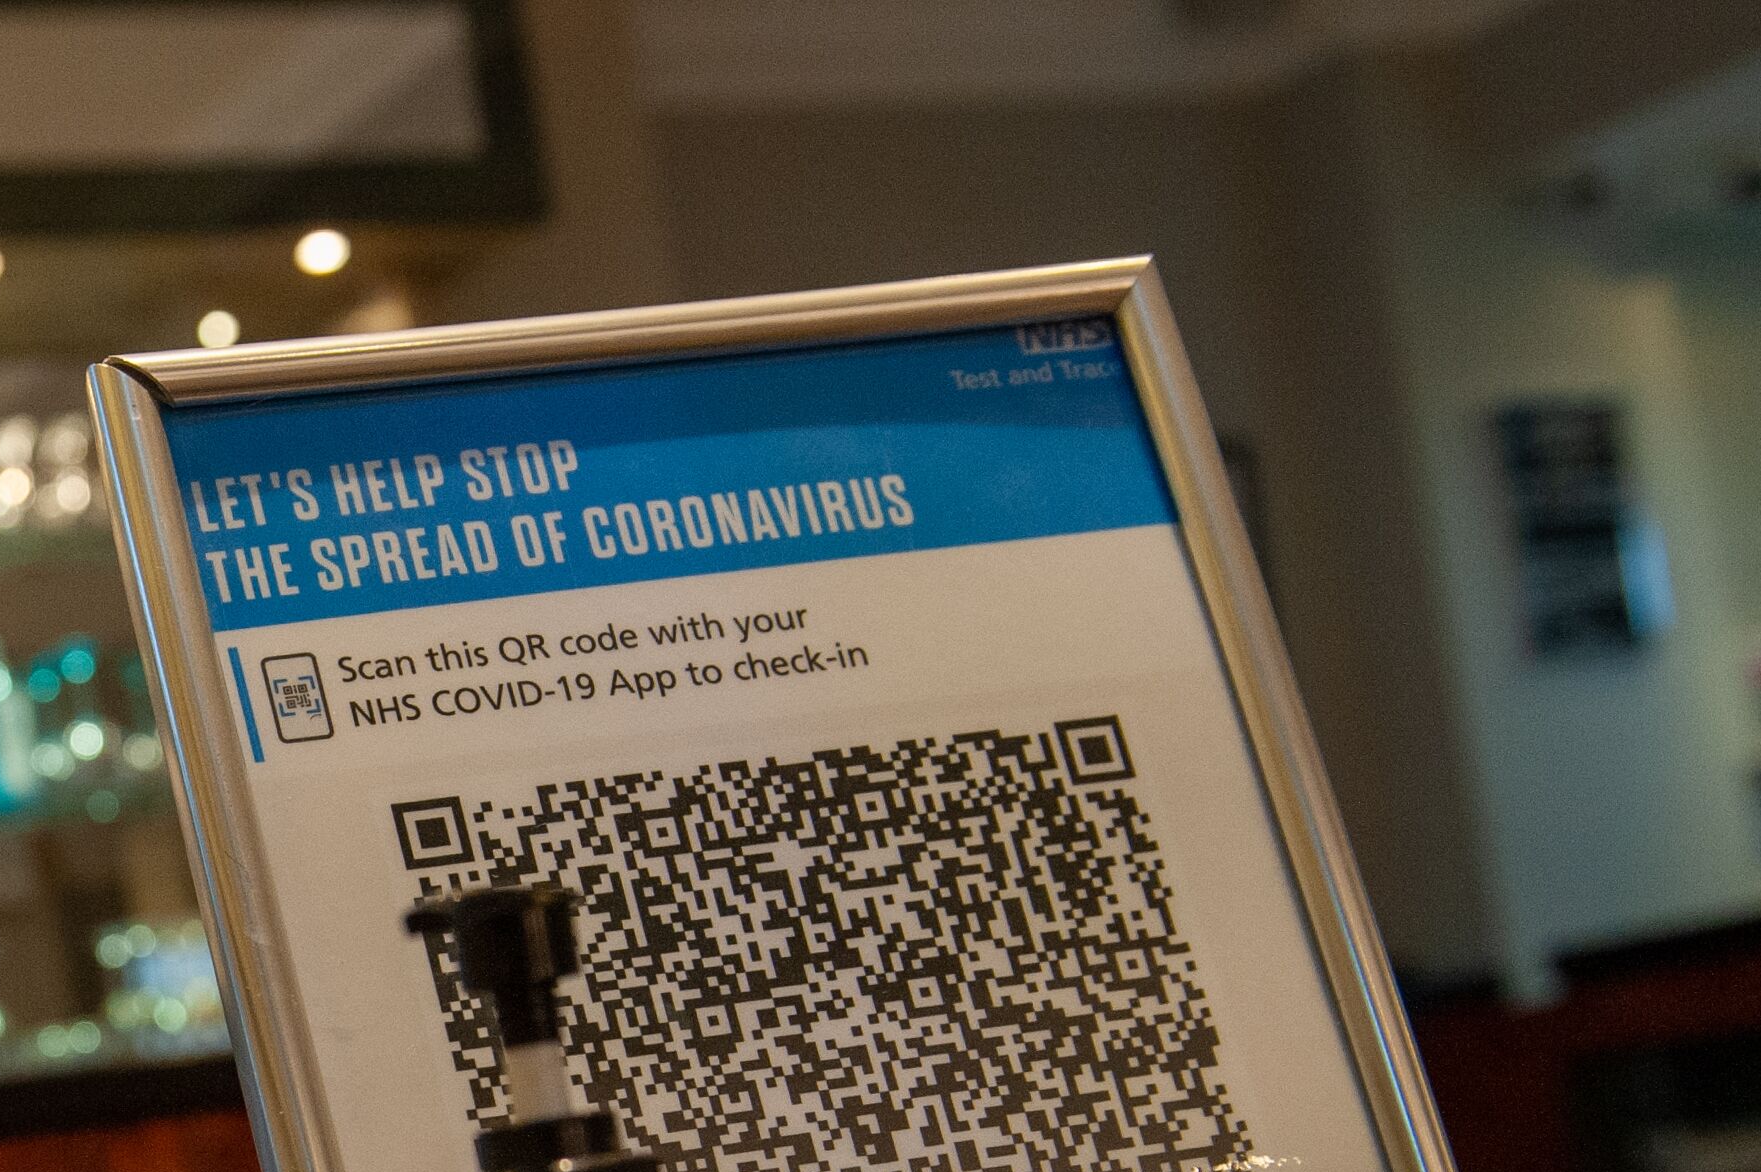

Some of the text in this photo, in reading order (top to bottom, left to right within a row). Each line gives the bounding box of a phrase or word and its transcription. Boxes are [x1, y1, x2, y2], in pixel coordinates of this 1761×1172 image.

[950, 369, 1002, 390] Test
[1008, 361, 1054, 385] and
[191, 439, 578, 532] LET'S HELP STOP
[205, 474, 915, 603] THE SPREAD OF CORONAVIRUS
[338, 608, 808, 683] Scan this QR code with your
[349, 642, 869, 727] NHS COVID-19 App to check-in
